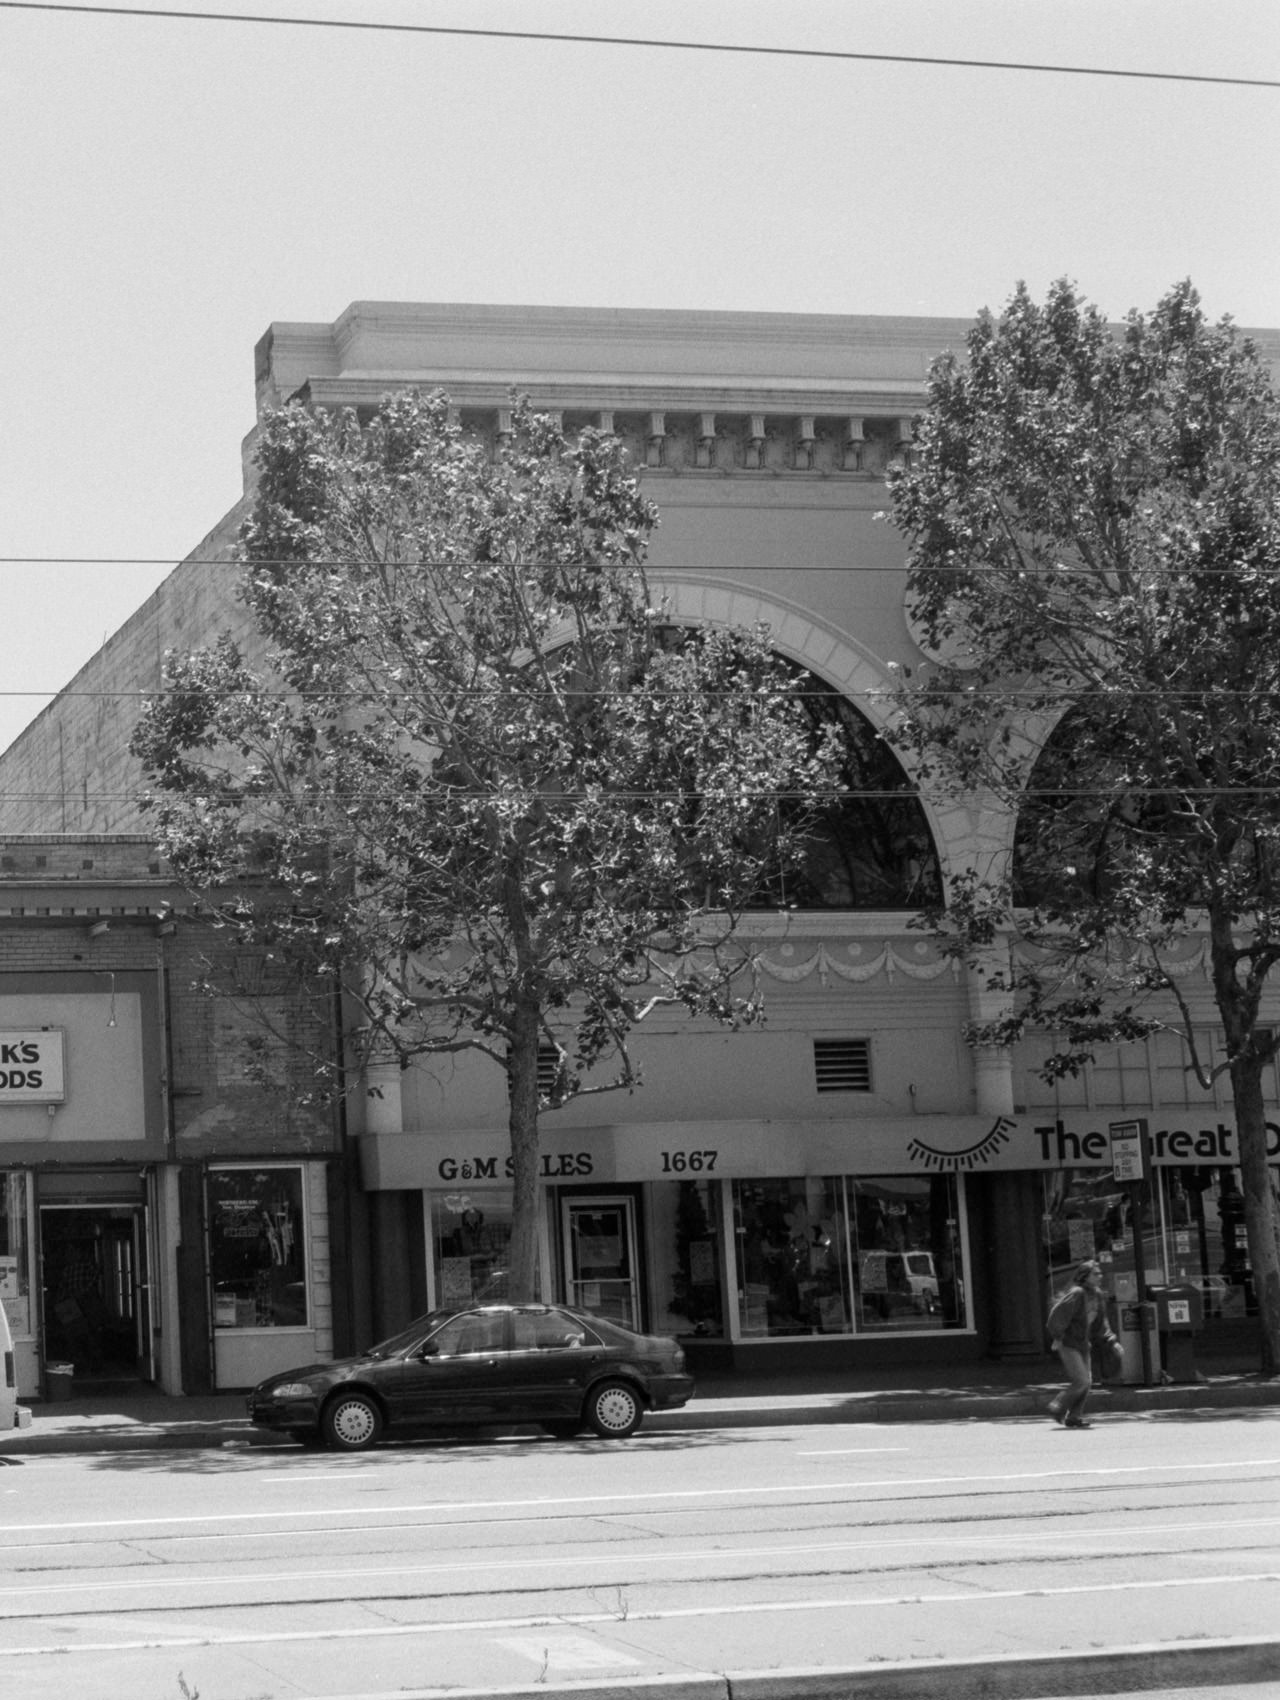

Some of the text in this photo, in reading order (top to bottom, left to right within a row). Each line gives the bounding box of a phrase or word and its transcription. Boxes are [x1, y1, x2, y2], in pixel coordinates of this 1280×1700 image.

[1034, 1119, 1108, 1160] The
[1148, 1123, 1232, 1158] reat
[438, 1152, 594, 1181] G&M SLES
[661, 1150, 718, 1173] 1667
